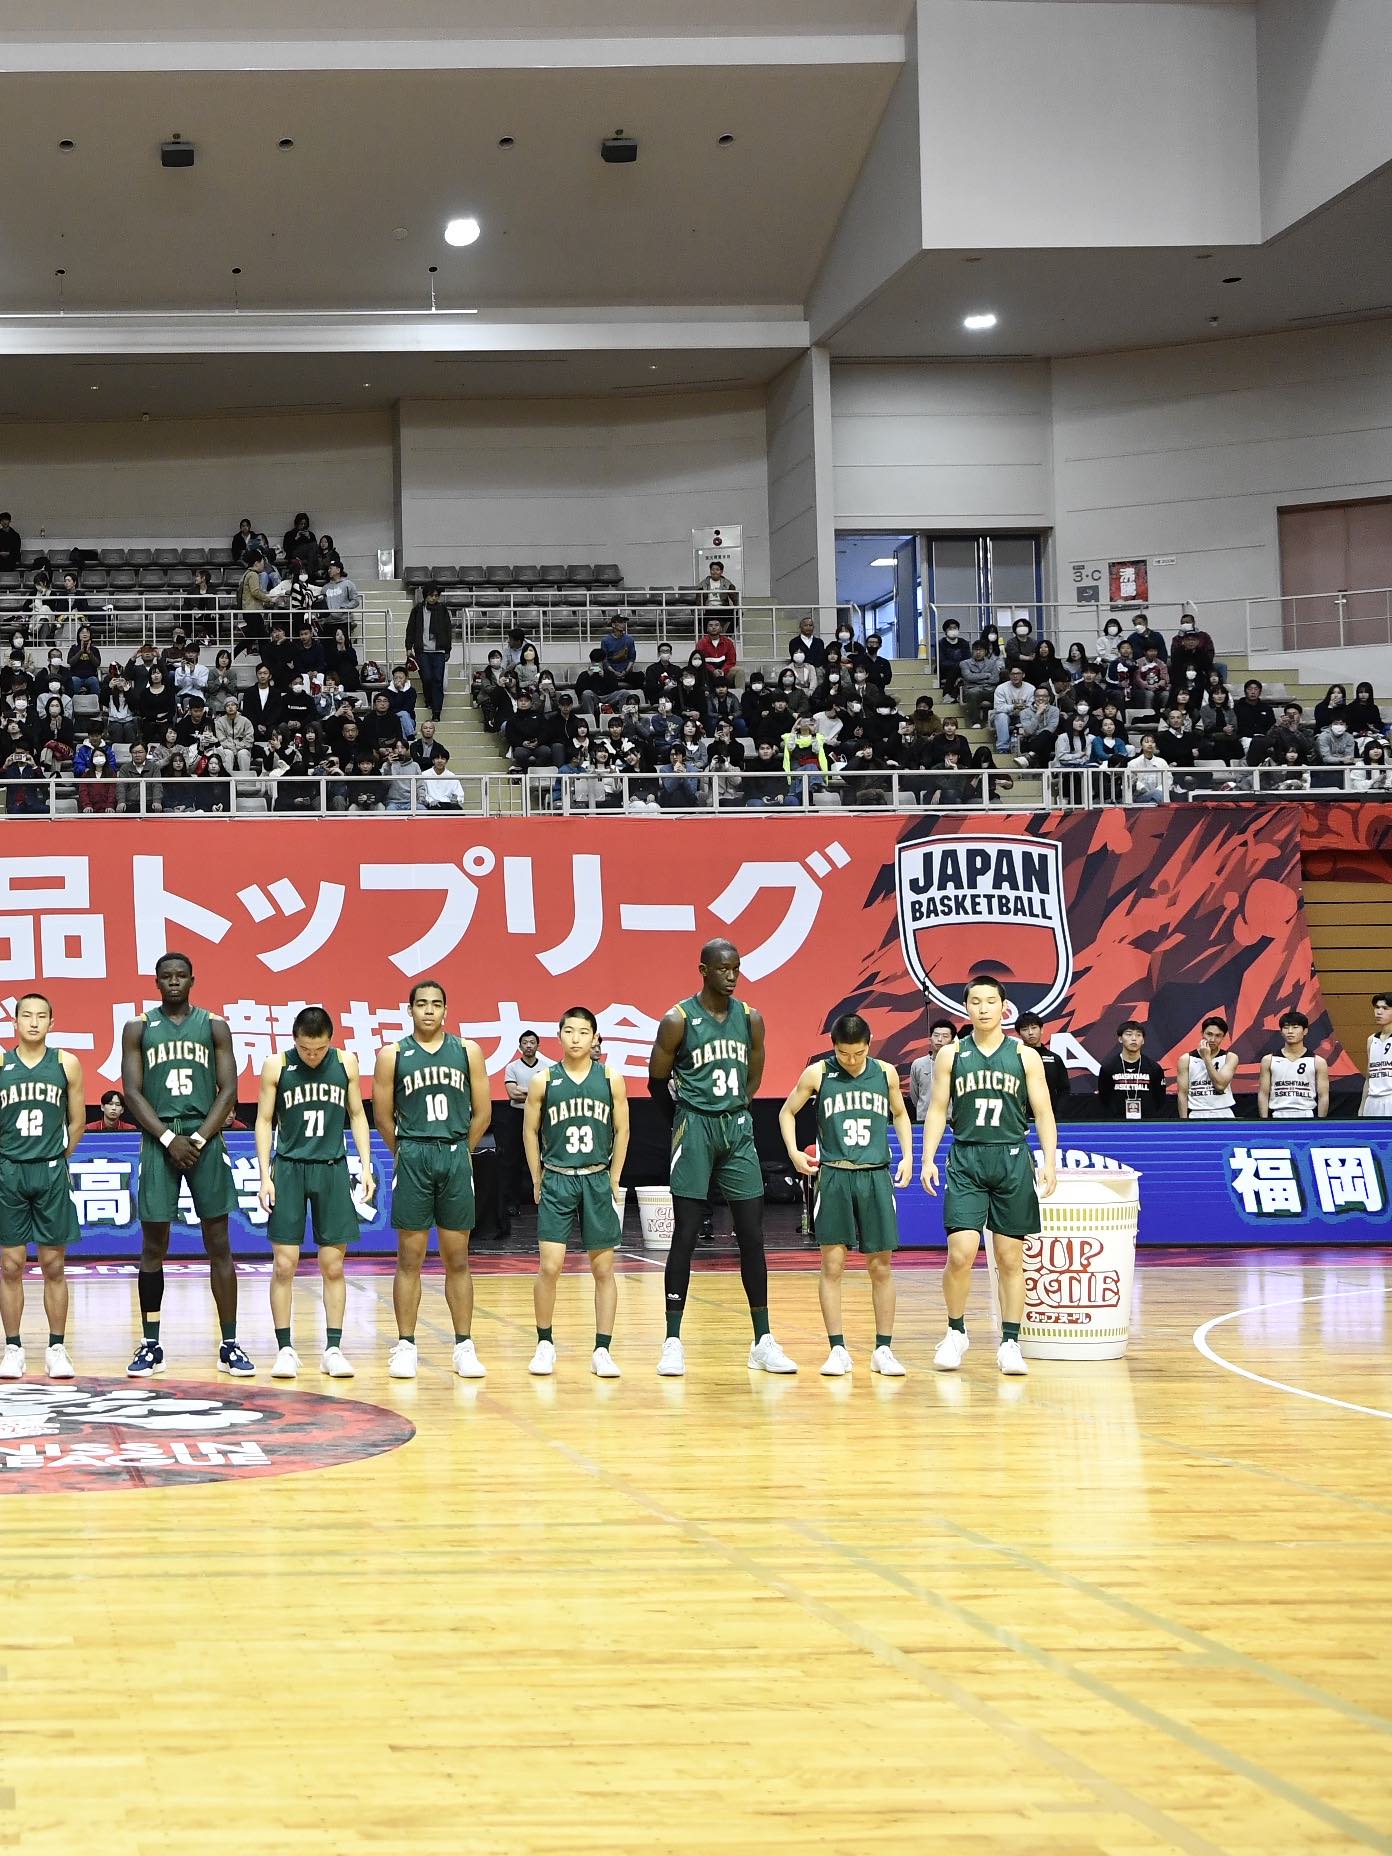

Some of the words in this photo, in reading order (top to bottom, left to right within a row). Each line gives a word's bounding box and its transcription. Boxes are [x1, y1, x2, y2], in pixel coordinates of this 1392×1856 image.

[908, 848, 1051, 896] JAPAN
[910, 895, 1054, 922] BASKETBALL
[148, 1040, 209, 1070] DAIICHI
[1384, 1043, 1391, 1055] 9
[165, 1068, 193, 1096] 45
[403, 1066, 465, 1095] DAIICHI
[1297, 1062, 1306, 1074] 8
[0, 1082, 63, 1109] DAIICHI
[283, 1083, 345, 1108] DAIICHI
[712, 1068, 739, 1097] 34
[956, 1069, 1020, 1097] DAIICHI
[425, 1094, 448, 1122] 10
[549, 1098, 611, 1126] DAIICHI
[824, 1091, 888, 1118] DAIICHI
[975, 1098, 1003, 1126] 77
[15, 1109, 43, 1136] 42
[303, 1110, 324, 1136] 71
[842, 1118, 871, 1146] 35
[565, 1125, 593, 1153] 33
[1229, 1147, 1384, 1213] 福岡
[1028, 1312, 1090, 1324] カップヌードル
